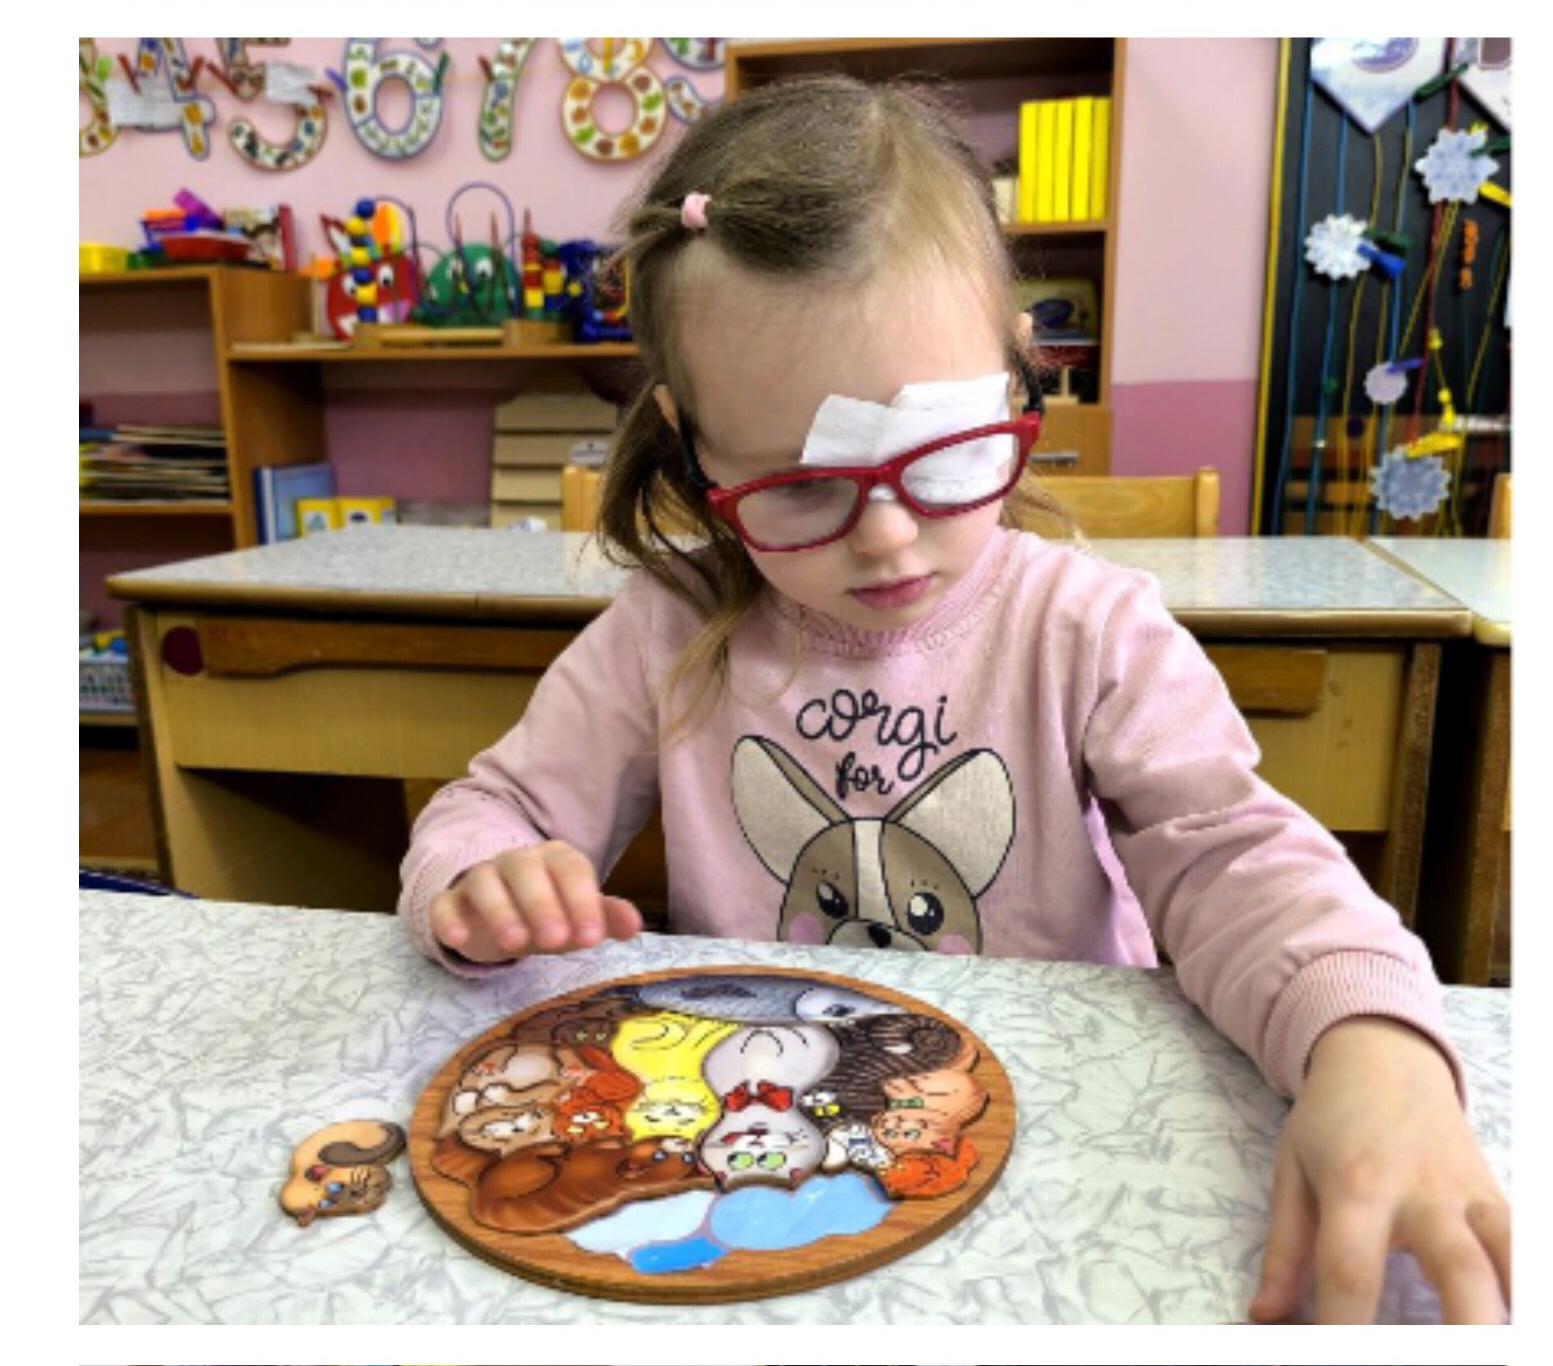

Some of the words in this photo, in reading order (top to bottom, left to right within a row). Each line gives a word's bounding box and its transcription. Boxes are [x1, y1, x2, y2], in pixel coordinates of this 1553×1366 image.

[217, 37, 328, 171] 5
[344, 37, 442, 161] 6
[559, 37, 667, 163] 8
[796, 689, 957, 781] corgi
[837, 751, 894, 800] for
